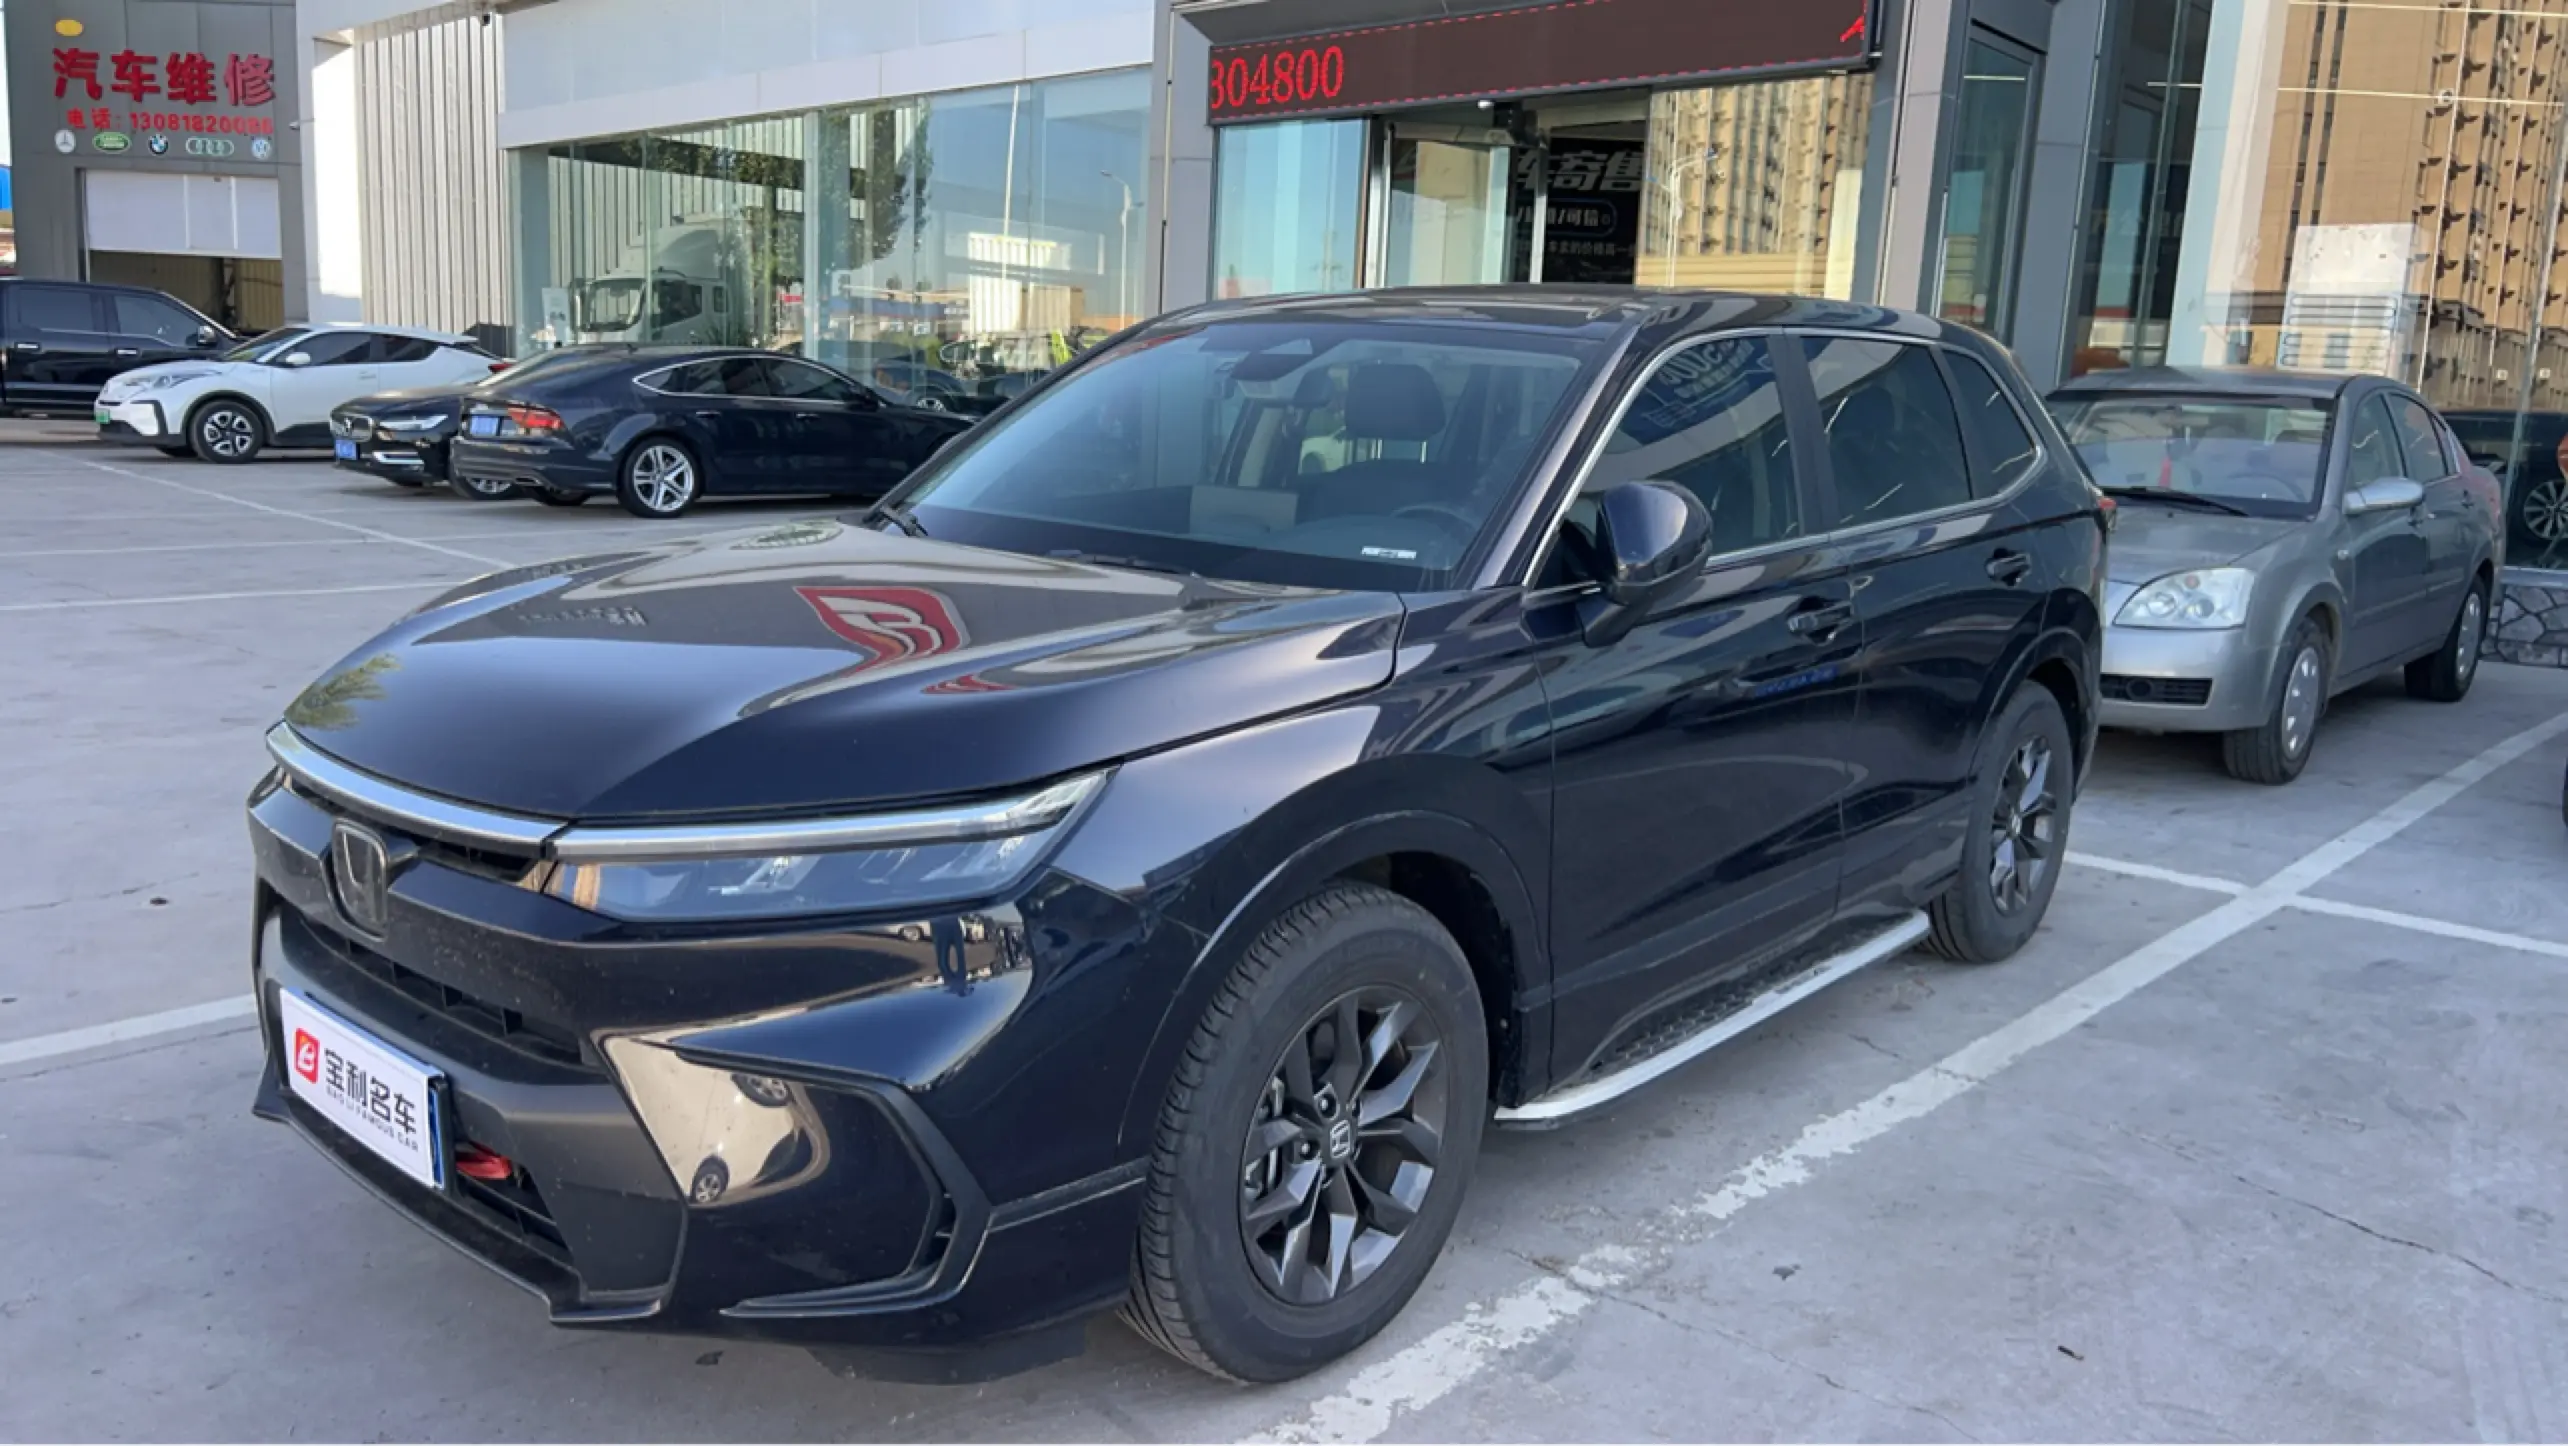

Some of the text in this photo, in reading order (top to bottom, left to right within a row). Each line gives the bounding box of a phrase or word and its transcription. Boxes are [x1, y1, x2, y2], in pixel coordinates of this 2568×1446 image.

[53, 48, 275, 106] 汽车维修
[324, 1047, 417, 1134] 宝利名车
